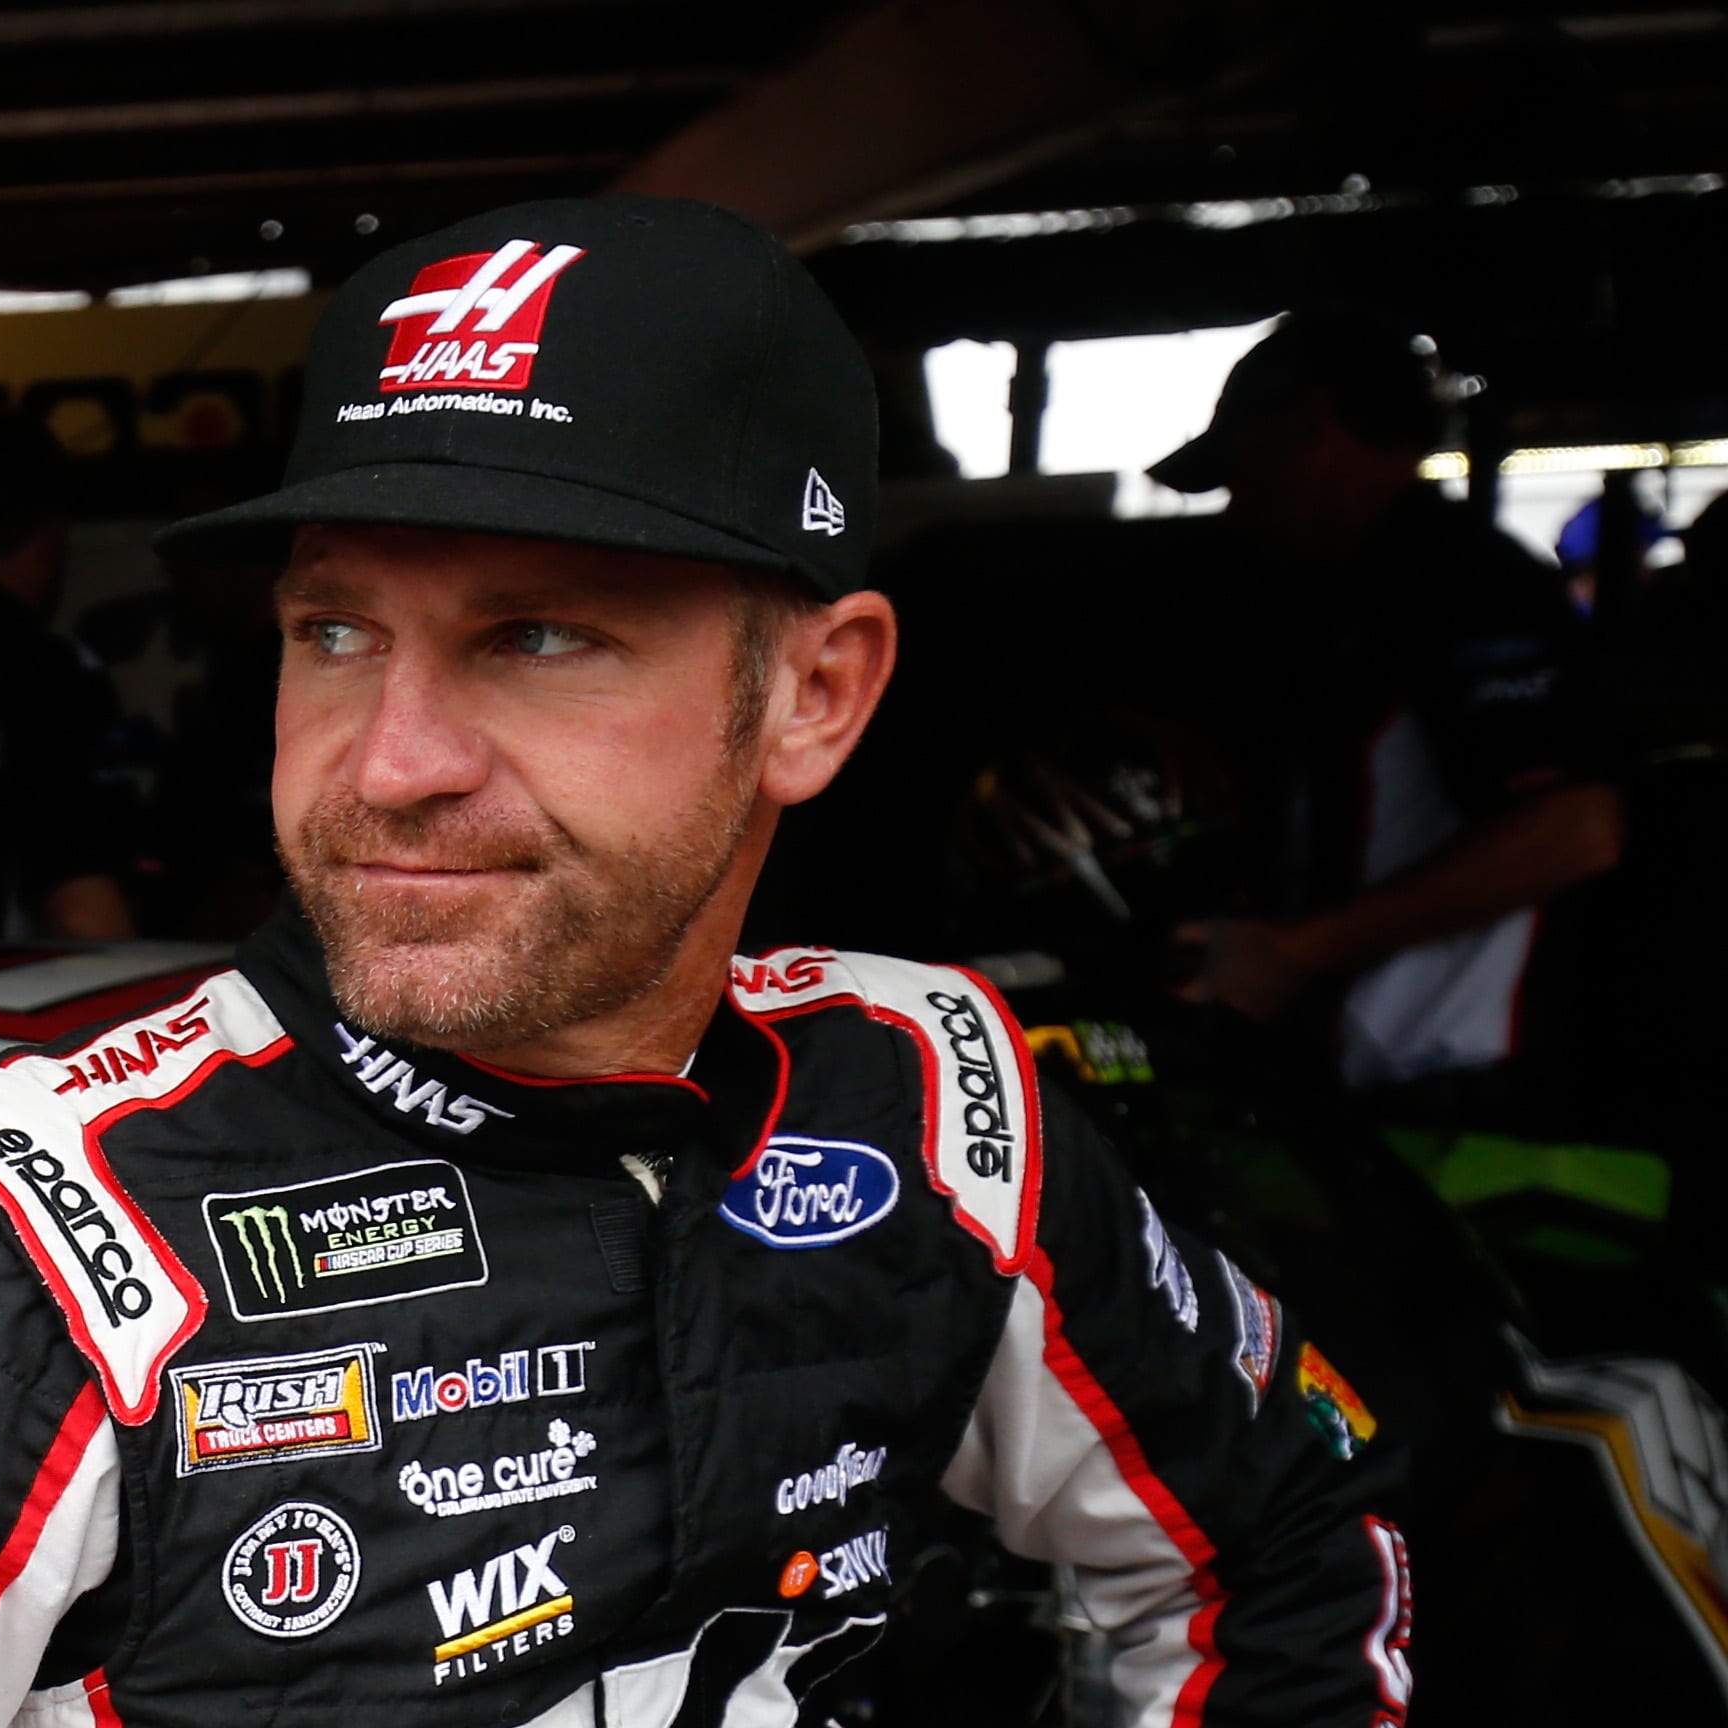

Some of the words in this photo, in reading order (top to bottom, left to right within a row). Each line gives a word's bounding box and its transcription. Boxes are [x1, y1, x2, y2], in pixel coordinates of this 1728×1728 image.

[378, 340, 540, 384] HAAS
[336, 401, 385, 422] Haas
[387, 392, 523, 418] Automation
[529, 397, 574, 423] Inc.
[53, 996, 210, 1094] HAAS
[334, 1022, 517, 1135] HAAS
[755, 1150, 864, 1228] Ford
[327, 1215, 437, 1249] ENERGY
[331, 1246, 386, 1270] NASCAR
[386, 1244, 414, 1261] CUP
[413, 1232, 465, 1256] SERIES
[197, 1366, 345, 1430] RUSH
[391, 1350, 531, 1423] Mobil
[205, 1420, 262, 1451] TRUCK
[262, 1416, 338, 1441] CENTERS
[406, 1460, 485, 1506] one
[493, 1446, 577, 1491] cure
[232, 1512, 288, 1577] JIMMY
[262, 1538, 323, 1605] JJ
[426, 1528, 570, 1639] WIX
[433, 1613, 577, 1687] FILTERS
